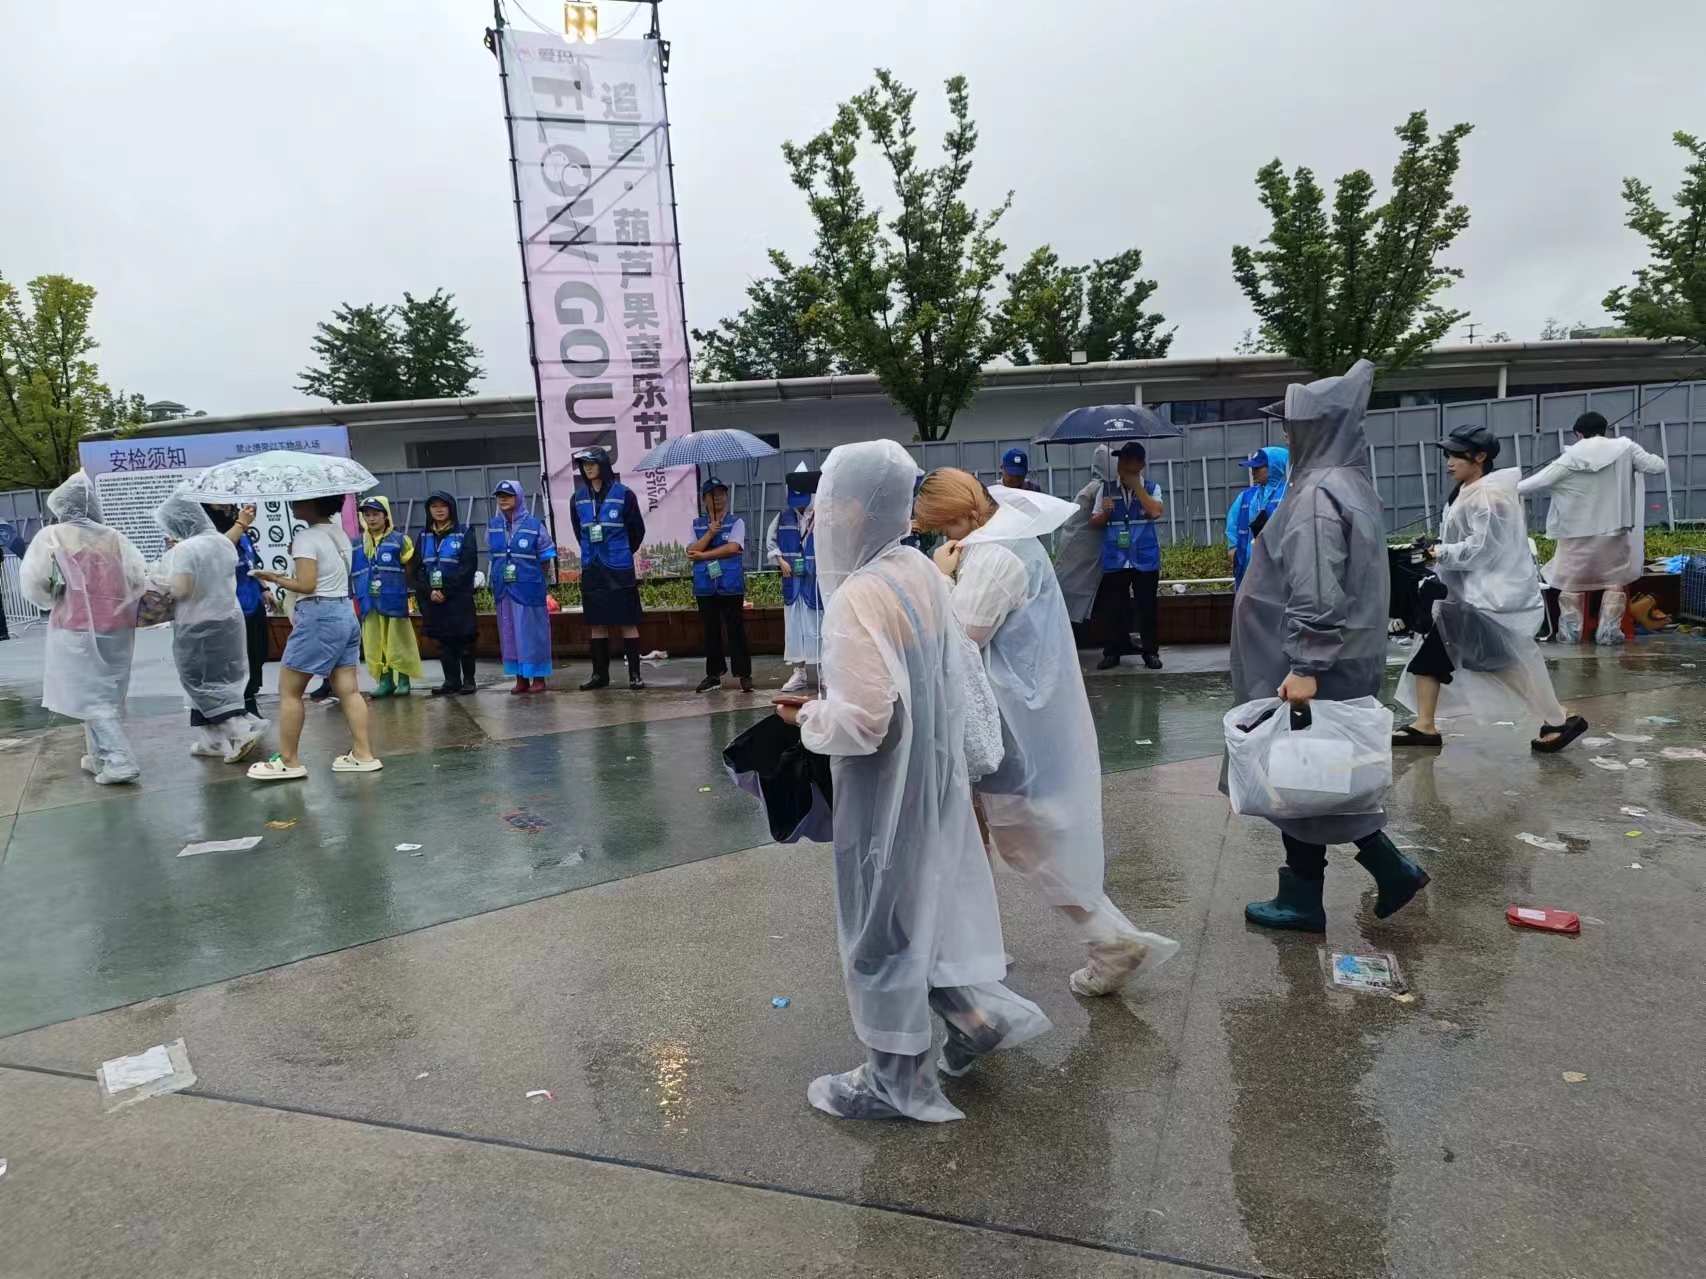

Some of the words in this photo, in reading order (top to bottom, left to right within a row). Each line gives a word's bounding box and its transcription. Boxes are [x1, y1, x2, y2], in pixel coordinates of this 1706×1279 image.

[554, 280, 621, 490] GOUR
[109, 446, 187, 473] 安检须知
[645, 469, 659, 513] STIVAL
[655, 466, 668, 495] USIC
